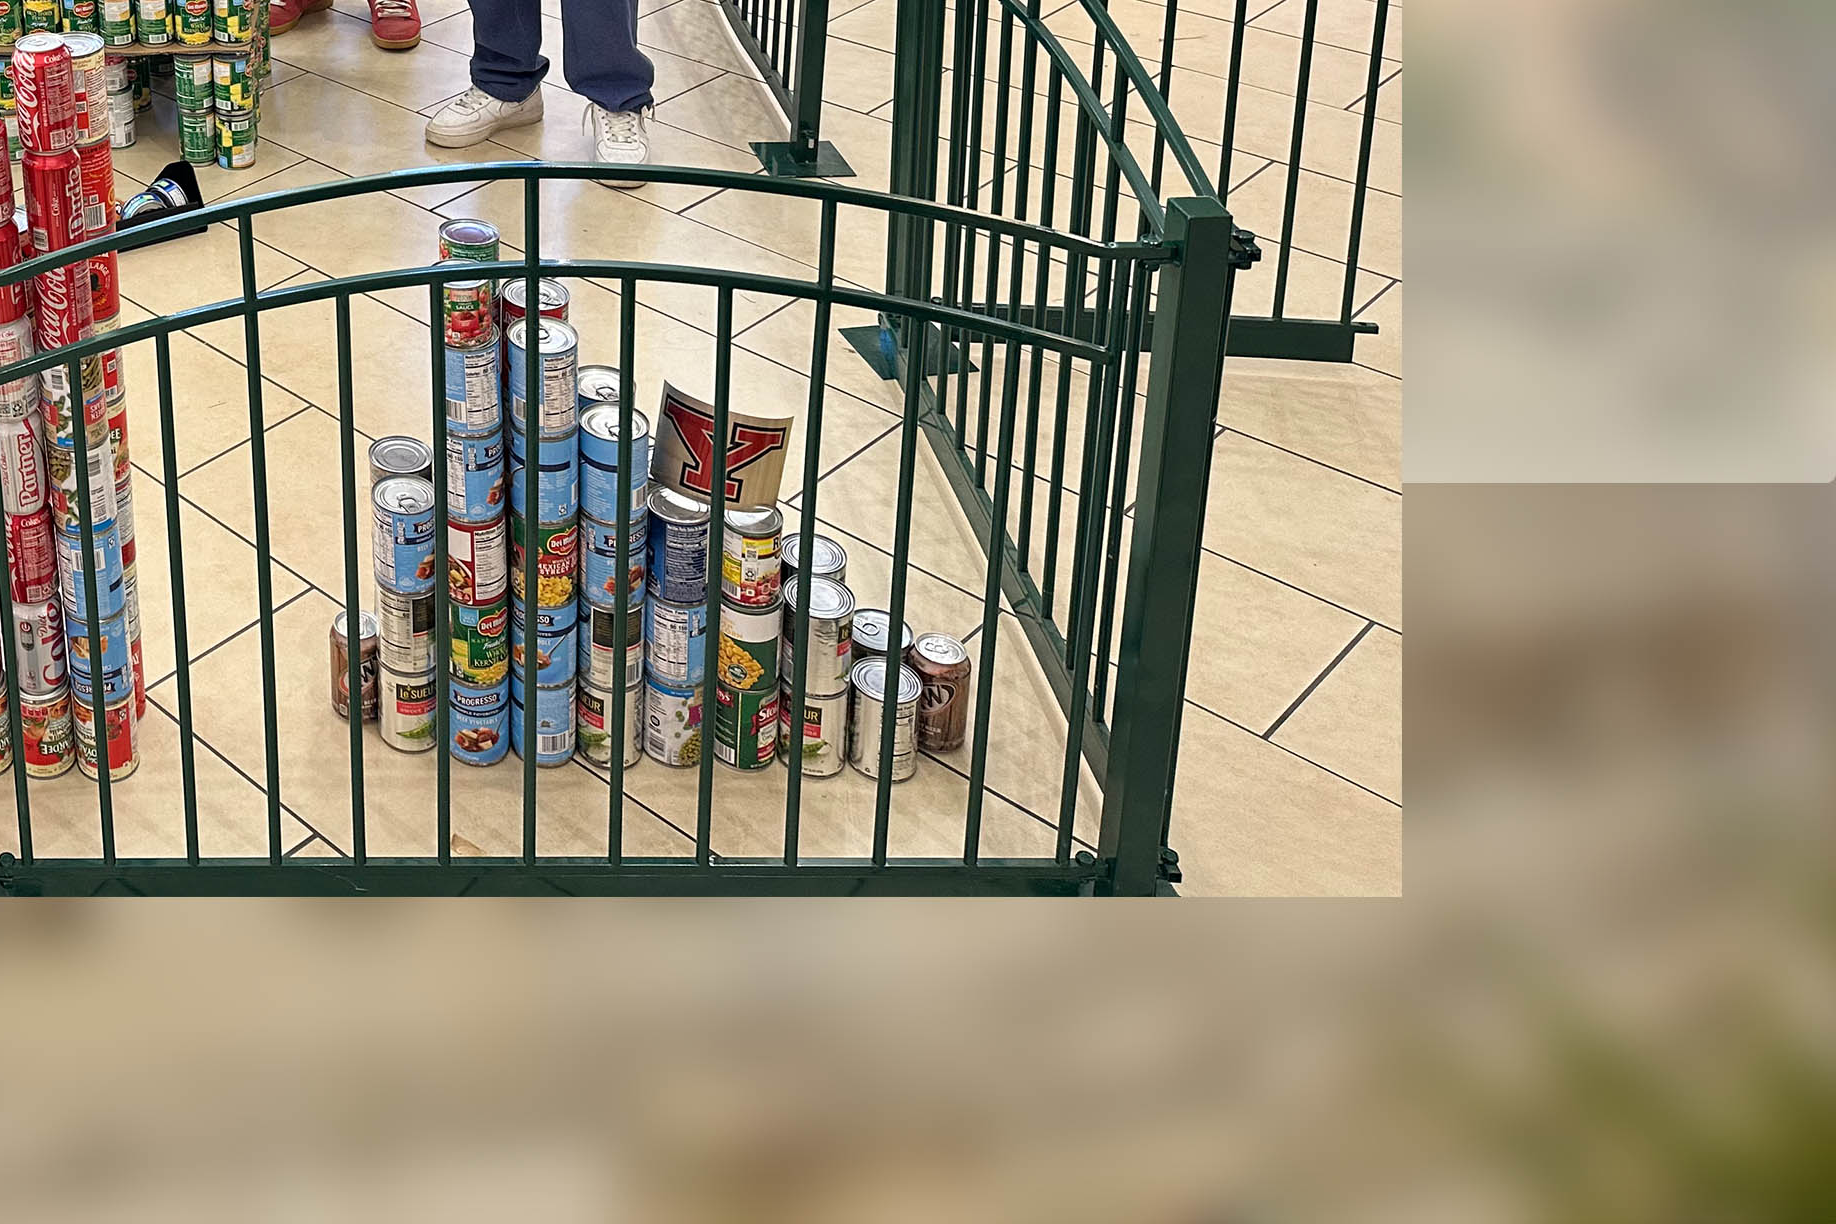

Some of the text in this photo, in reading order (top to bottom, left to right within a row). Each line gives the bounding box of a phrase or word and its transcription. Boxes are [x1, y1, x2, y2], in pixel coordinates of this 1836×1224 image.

[44, 53, 64, 64] Coke
[18, 429, 38, 507] Partner
[457, 694, 497, 706] PROGRESSO
